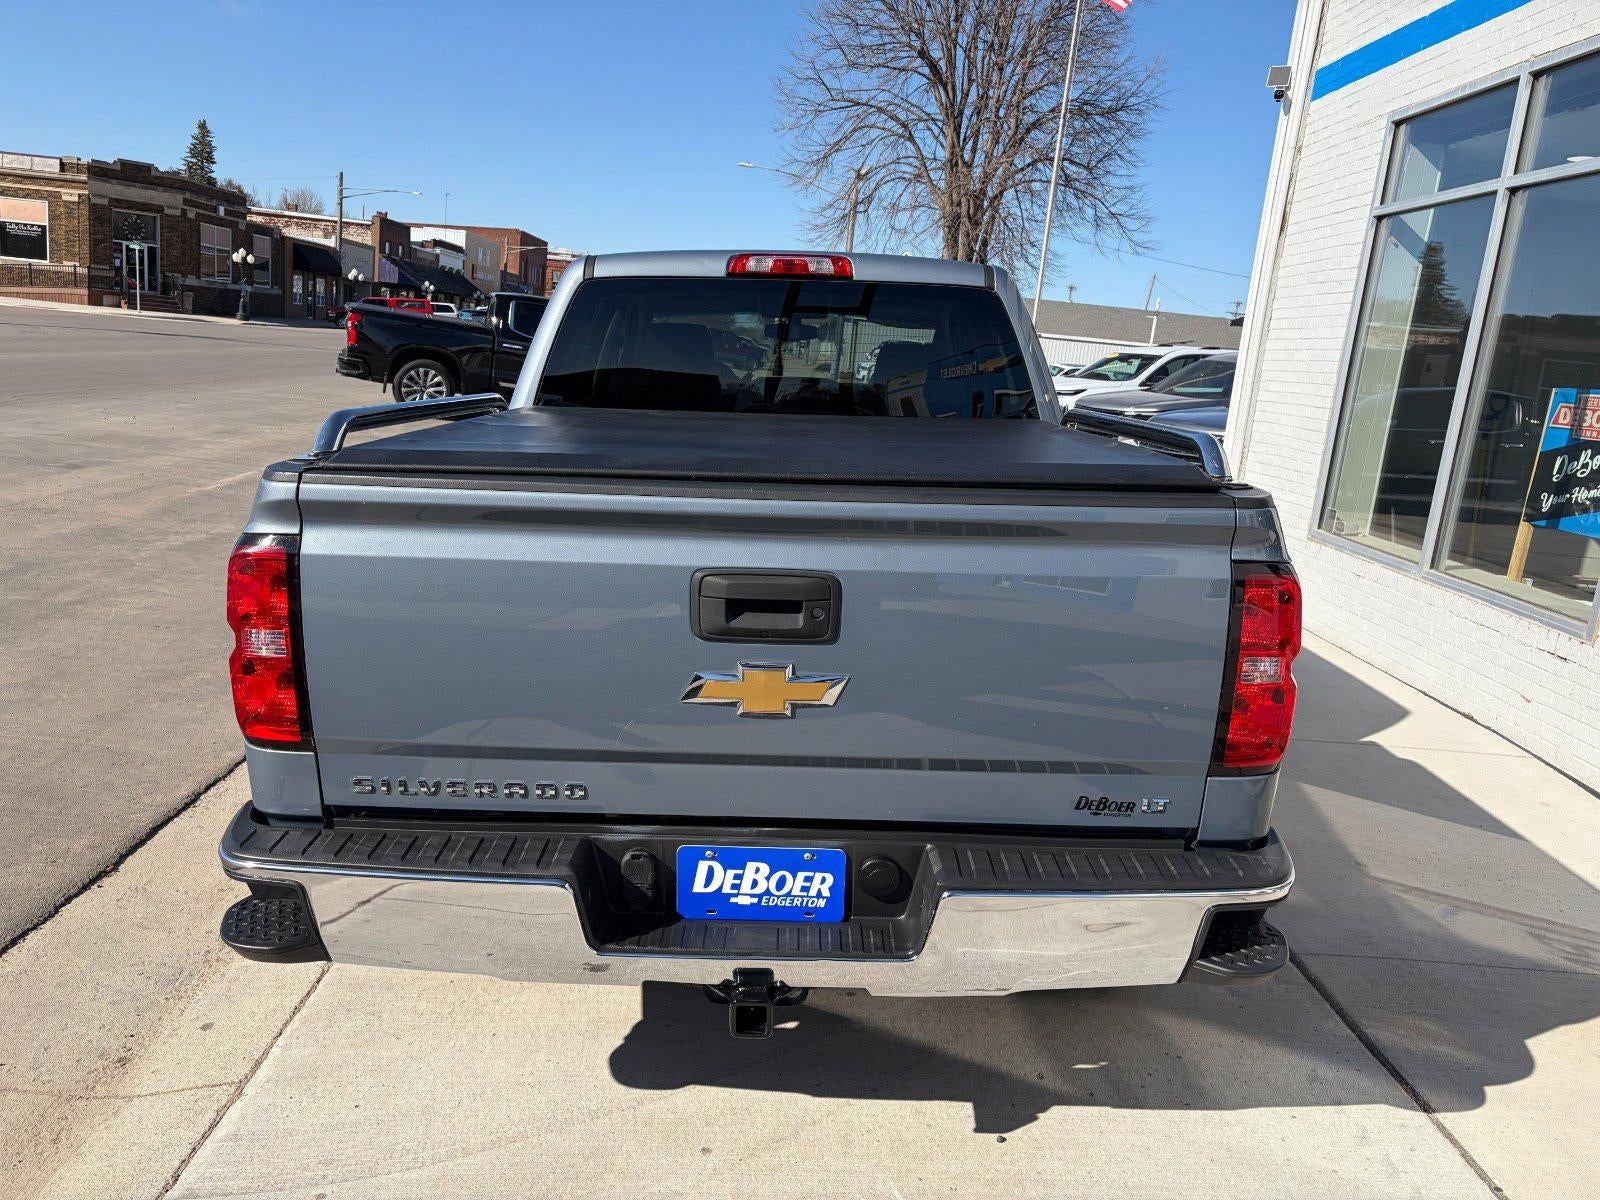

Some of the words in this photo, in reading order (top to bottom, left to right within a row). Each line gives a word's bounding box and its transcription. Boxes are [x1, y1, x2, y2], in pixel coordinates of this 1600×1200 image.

[1541, 492, 1570, 512] Your
[1571, 484, 1600, 504] Home
[352, 776, 590, 800] SILVERADO
[1074, 795, 1136, 813] DEBOER
[1141, 798, 1171, 813] LT
[692, 859, 834, 897] DEBOER
[760, 895, 827, 908] EDGERTON
